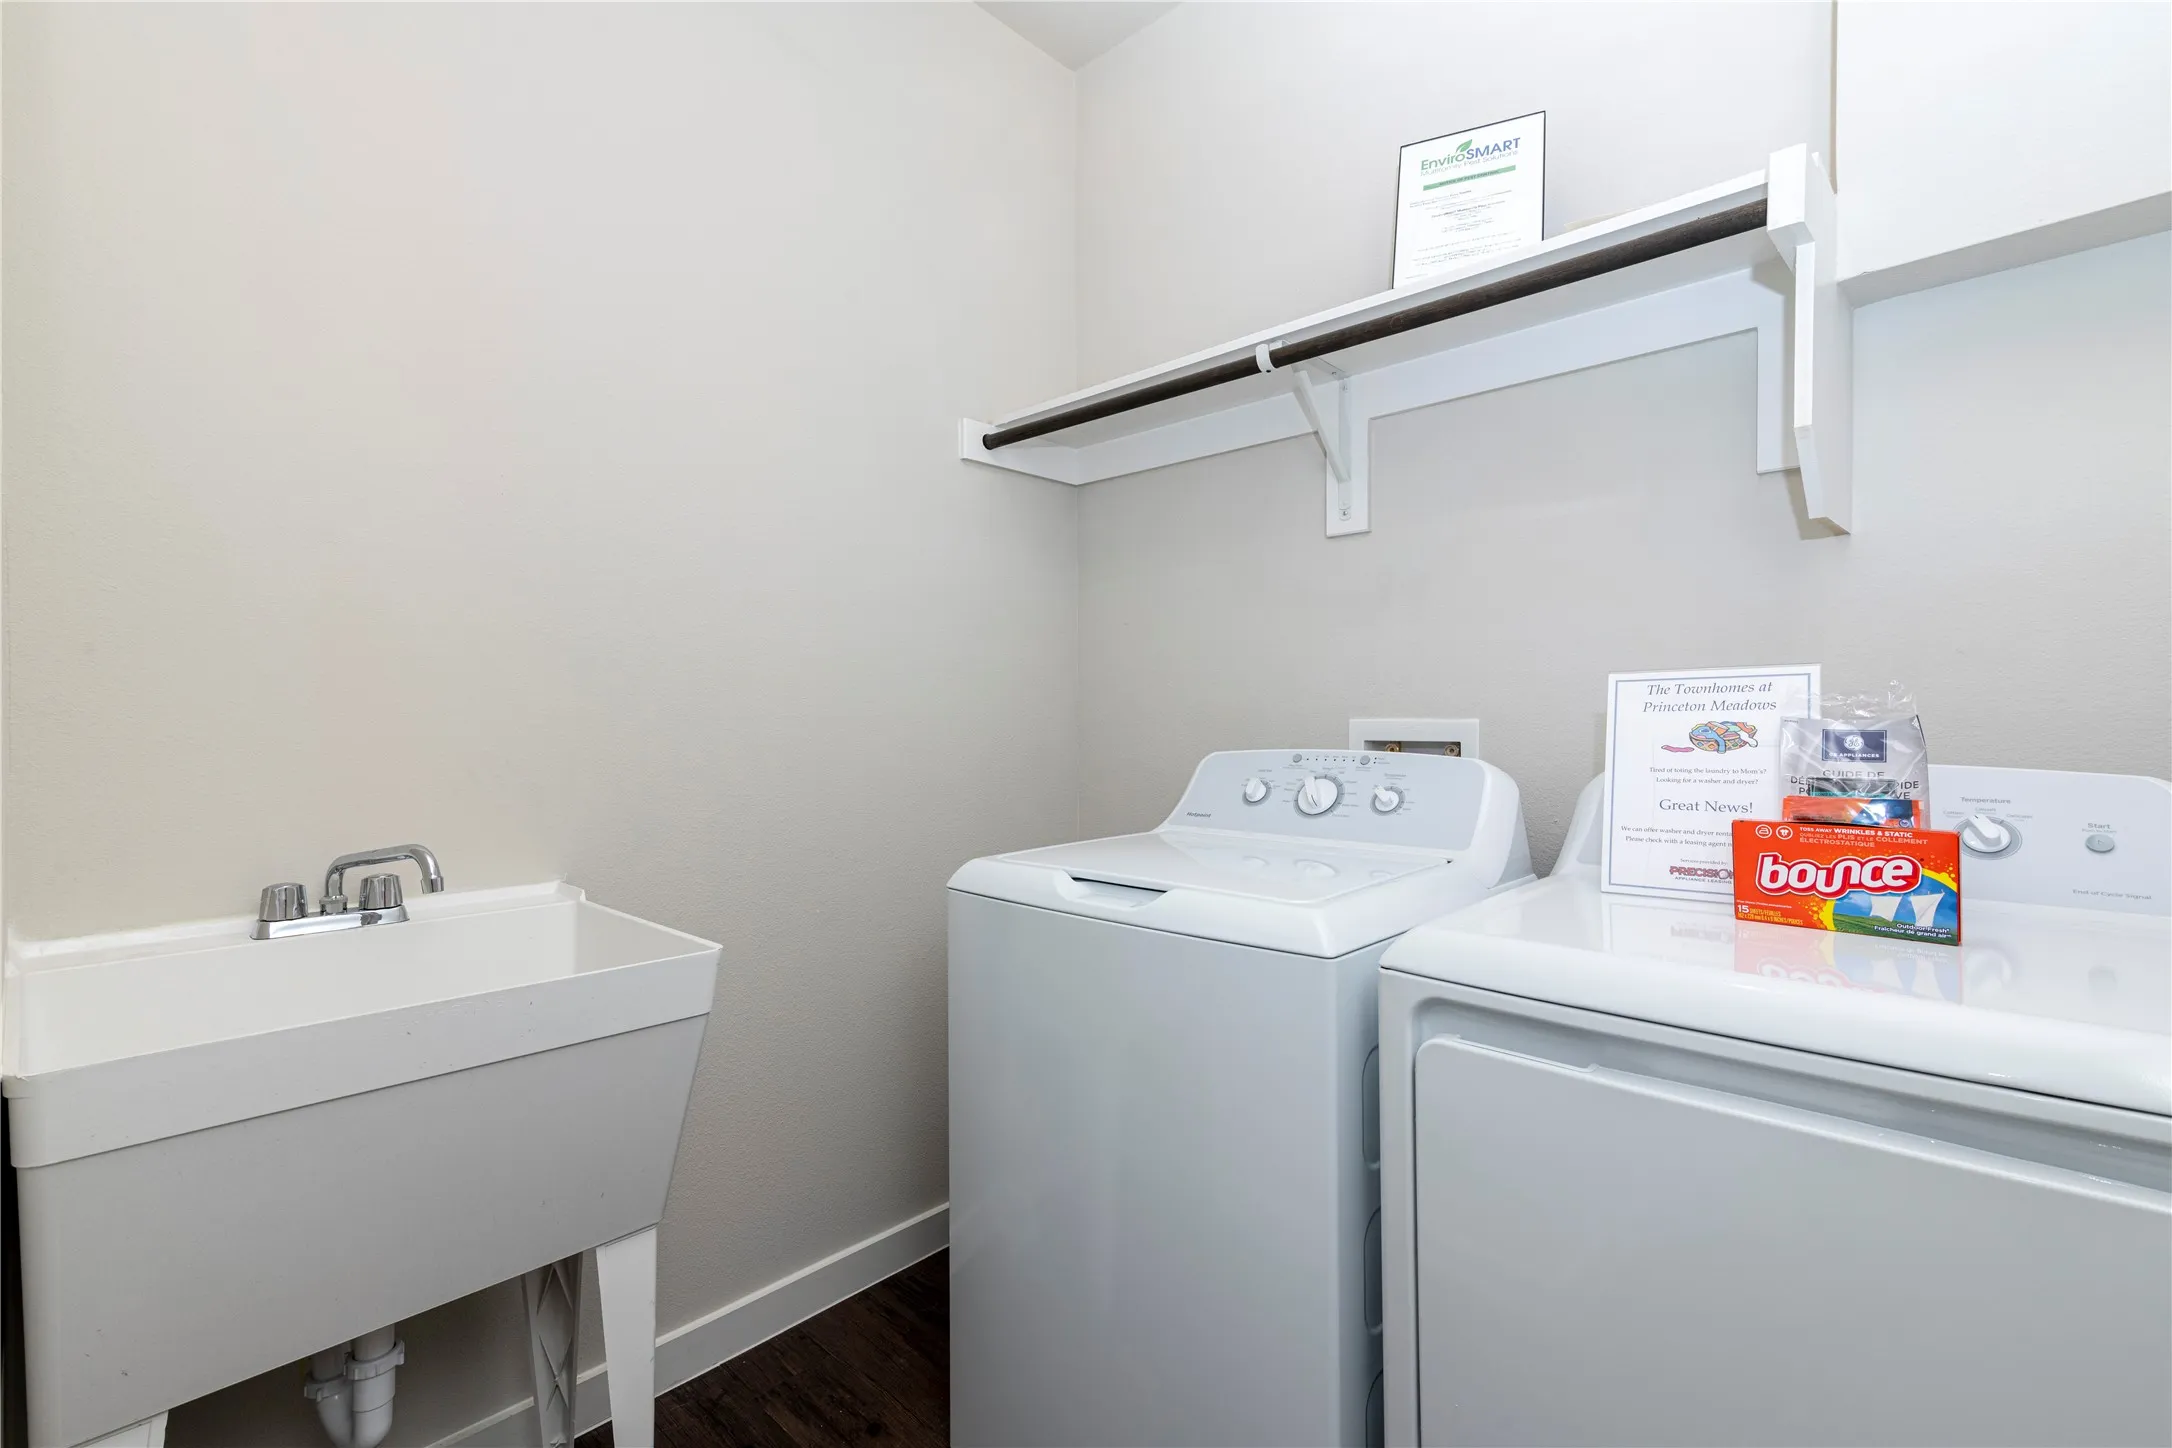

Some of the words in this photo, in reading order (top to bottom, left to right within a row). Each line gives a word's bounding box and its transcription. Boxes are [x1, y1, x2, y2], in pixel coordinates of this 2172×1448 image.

[1420, 137, 1521, 171] EnviroSMART
[1464, 158, 1481, 167] Pest
[1482, 149, 1519, 163] Solutions
[1647, 684, 1671, 696] The
[1674, 682, 1755, 695] Townhomes
[1758, 681, 1773, 693] at
[1642, 701, 1706, 713] Princeton
[1710, 699, 1777, 712] Meadows
[1649, 766, 1665, 774] Tired
[1705, 768, 1731, 776] laundry
[1822, 769, 1863, 778] GUIDE
[1656, 776, 1682, 785] Looking
[1682, 776, 1692, 784] for
[1736, 778, 1759, 786] dryer?
[1960, 796, 2011, 804] Temperature
[1659, 798, 1701, 812] Great
[1704, 800, 1753, 814] News!
[1697, 829, 1714, 837] dryer
[1834, 828, 1876, 837] WRINKLES
[1625, 835, 1645, 843] Please
[1684, 838, 1707, 847] leasing
[1799, 837, 1876, 848] ÉLECTROSTATIQUE
[1875, 836, 1929, 845] COLLEMENT
[1758, 853, 1917, 897] bounce
[1737, 904, 1750, 913] 15
[1896, 923, 1926, 931] Outdoor
